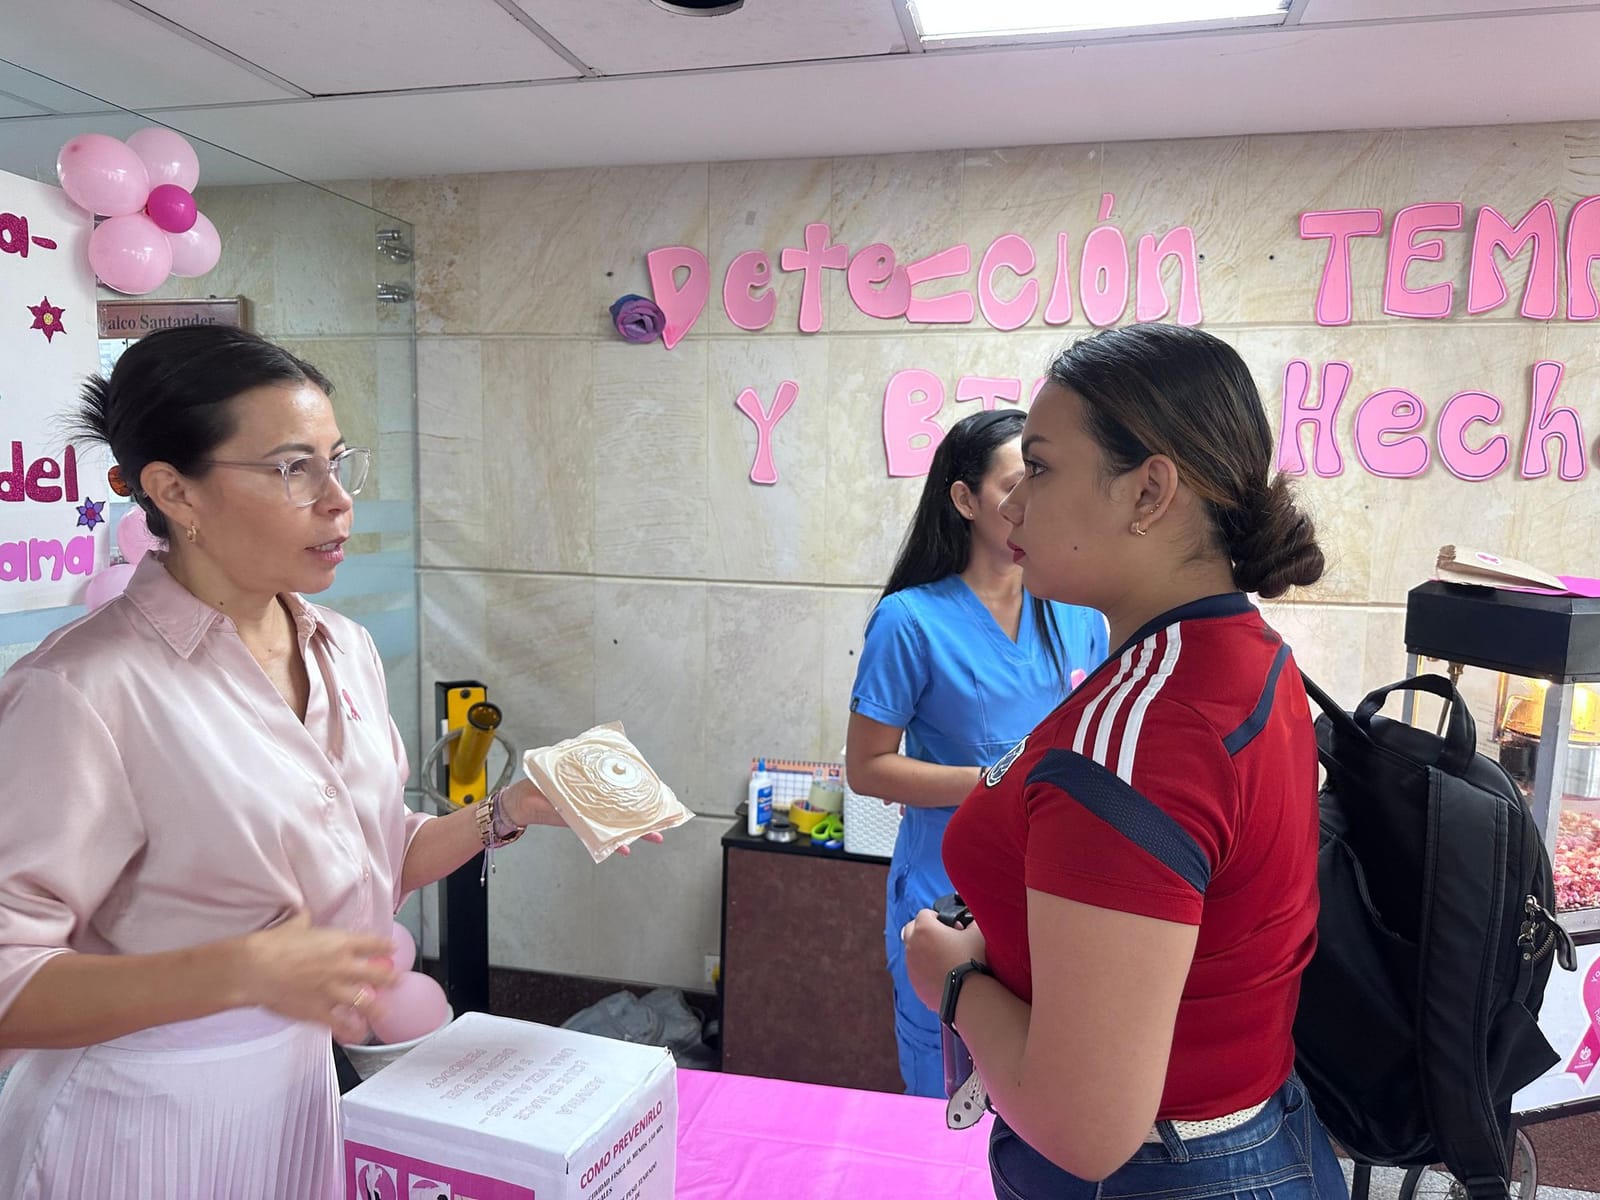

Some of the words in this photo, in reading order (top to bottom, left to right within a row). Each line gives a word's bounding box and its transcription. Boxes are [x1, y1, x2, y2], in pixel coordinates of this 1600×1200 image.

[107, 315, 136, 330] alco
[139, 314, 216, 330] Santander
[734, 380, 799, 485] Y
[1277, 359, 1600, 481] Hech
[580, 1151, 611, 1189] COMO
[612, 1100, 663, 1159] PREVENIRLO
